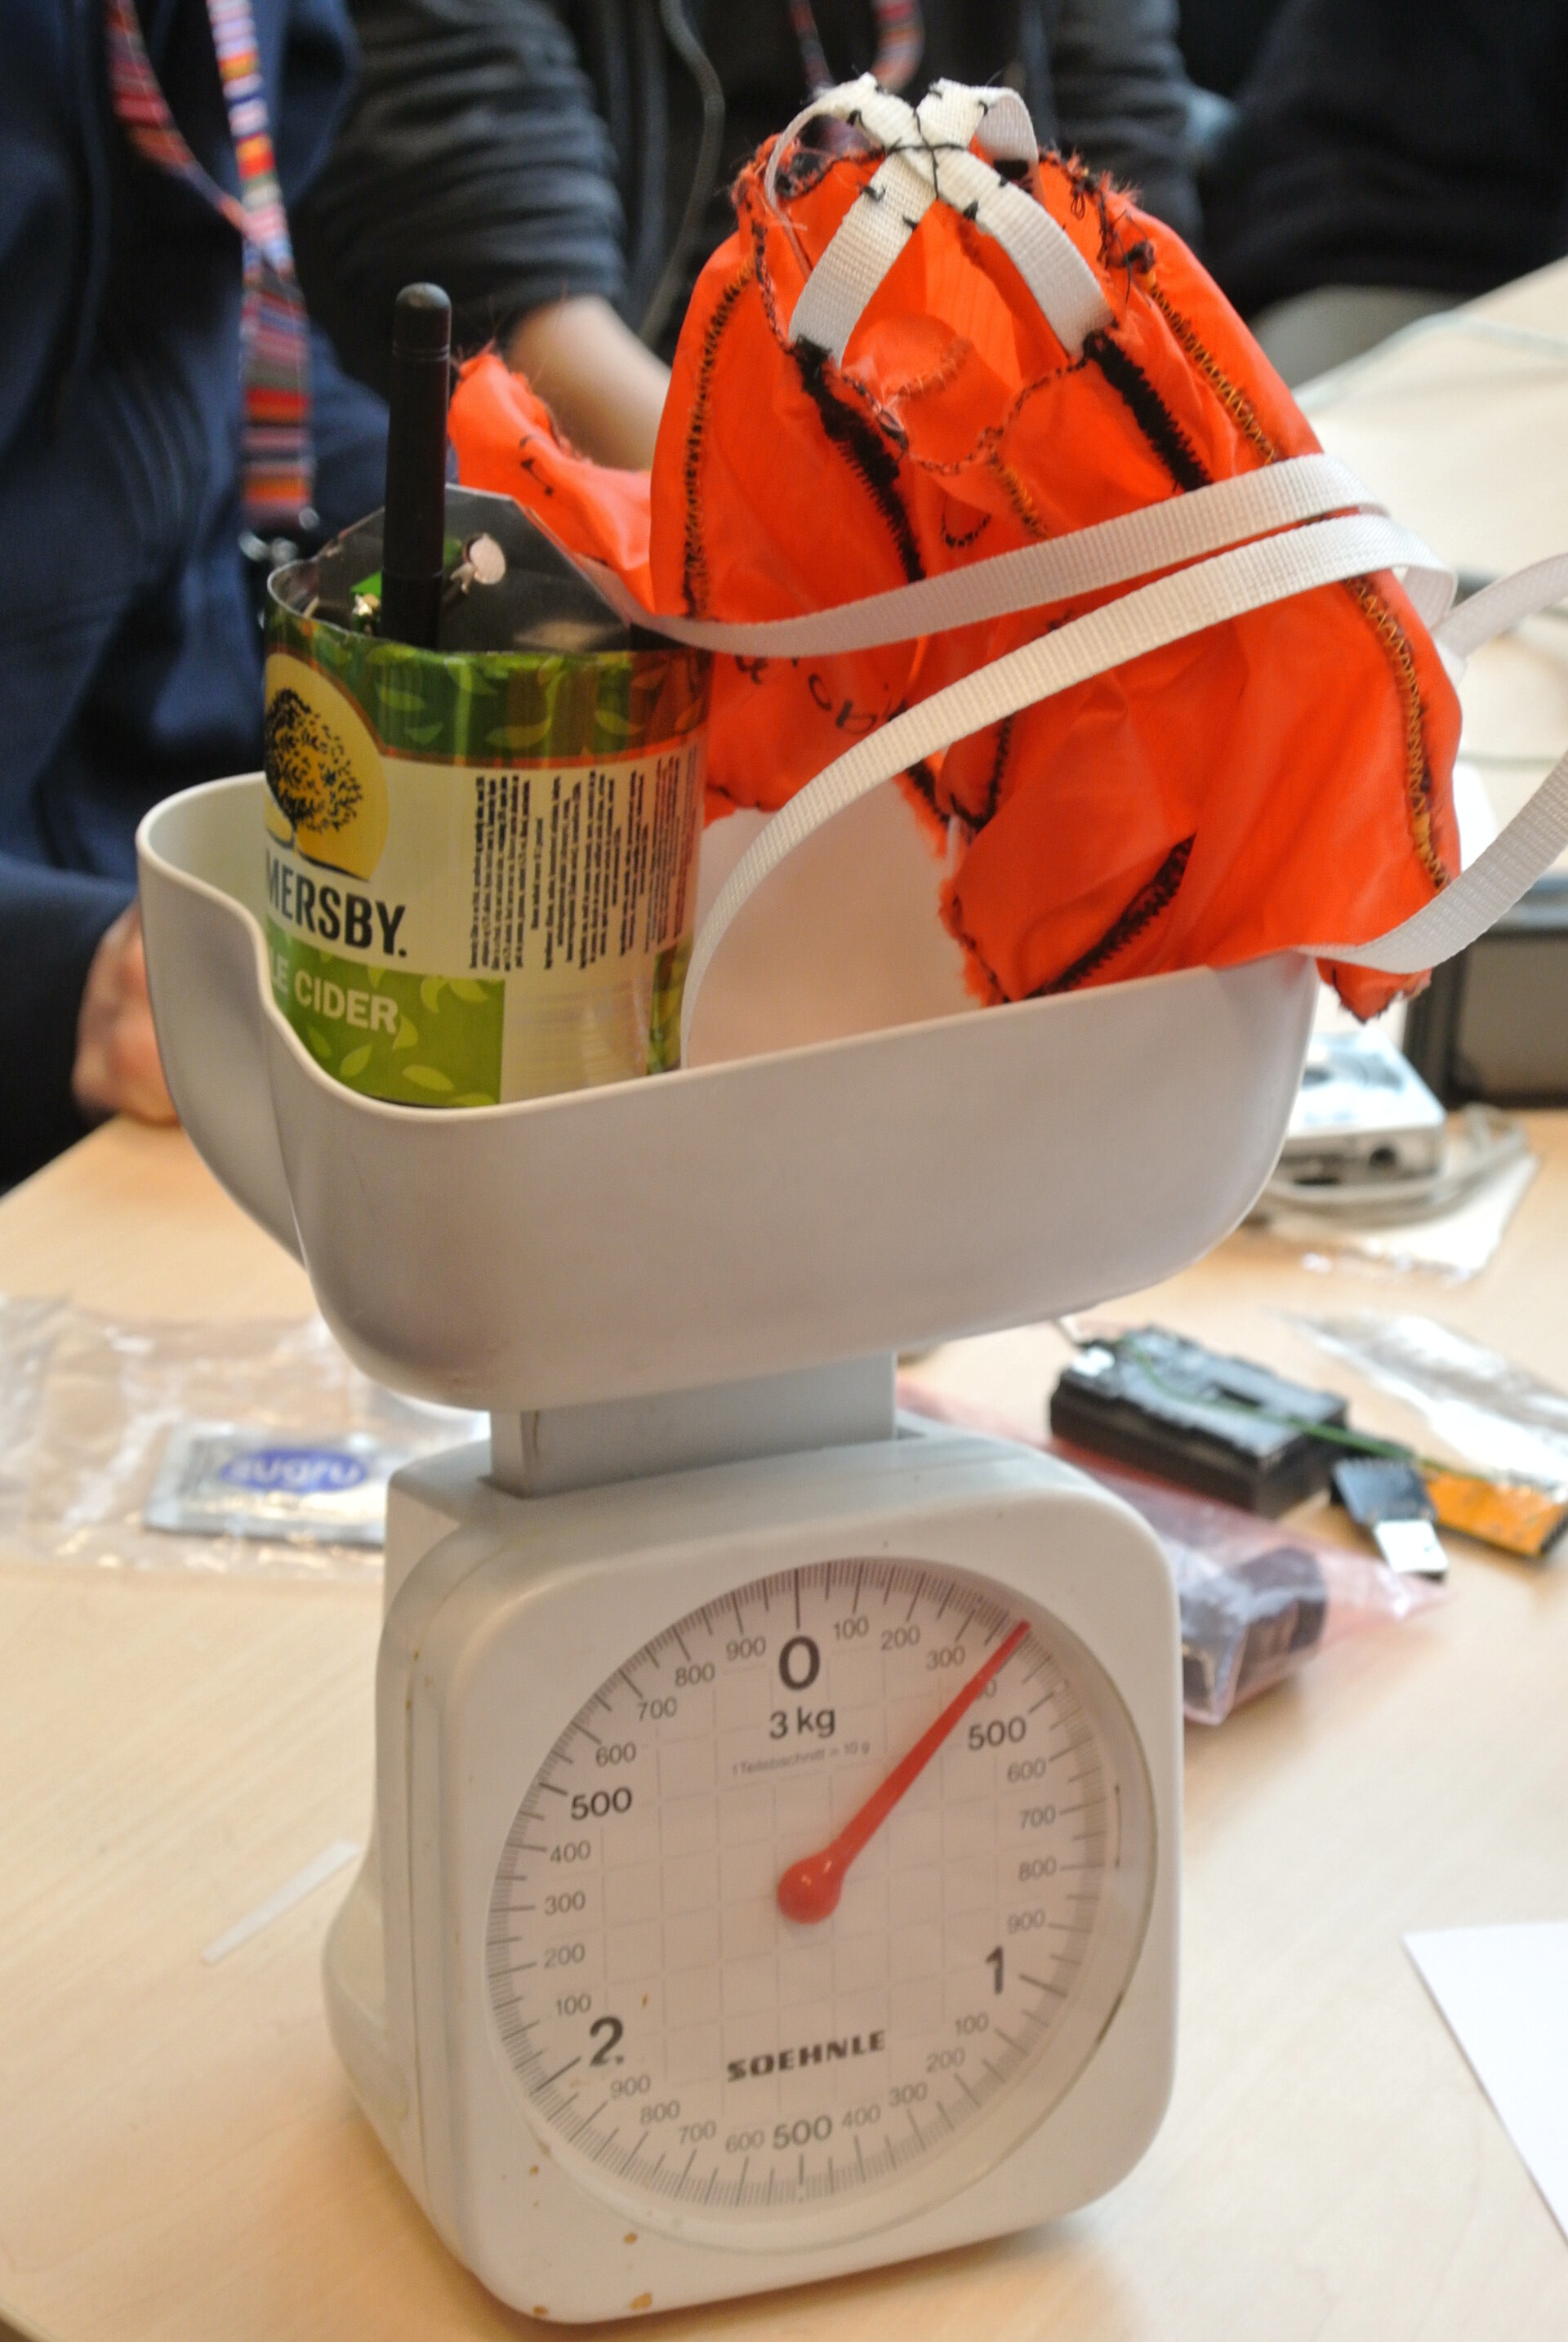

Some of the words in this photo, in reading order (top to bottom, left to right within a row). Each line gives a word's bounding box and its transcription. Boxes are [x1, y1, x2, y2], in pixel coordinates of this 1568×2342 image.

[294, 969, 398, 1034] CIDER
[833, 1616, 870, 1641] 100
[880, 1625, 921, 1651] 200
[726, 1636, 767, 1662] 900
[926, 1645, 965, 1671] 300
[675, 1662, 716, 1688] 800
[778, 1636, 821, 1690] 0
[637, 1696, 678, 1722] 700
[769, 1711, 789, 1740] 3
[797, 1706, 836, 1739] kg
[967, 1716, 1027, 1752] 500
[595, 1742, 637, 1767] 600
[1007, 1758, 1046, 1783] 600
[570, 1787, 633, 1821] 500
[1020, 1804, 1056, 1830] 700
[550, 1839, 591, 1863] 400
[1018, 1854, 1058, 1881] 800
[544, 1890, 586, 1916] 300
[1007, 1907, 1046, 1935] 900
[544, 1943, 586, 1969] 200
[984, 1945, 1004, 1995] 1
[556, 1992, 592, 2016] 100
[955, 2012, 989, 2036] 100
[727, 2029, 885, 2083] SOEHNLE
[926, 2047, 966, 2073] 200
[610, 2074, 651, 2099] 900
[889, 2082, 928, 2108] 300
[639, 2100, 680, 2125] 800
[841, 2104, 881, 2129] 400
[679, 2122, 716, 2145] 700
[725, 2130, 765, 2154] 600
[773, 2115, 832, 2151] 500
